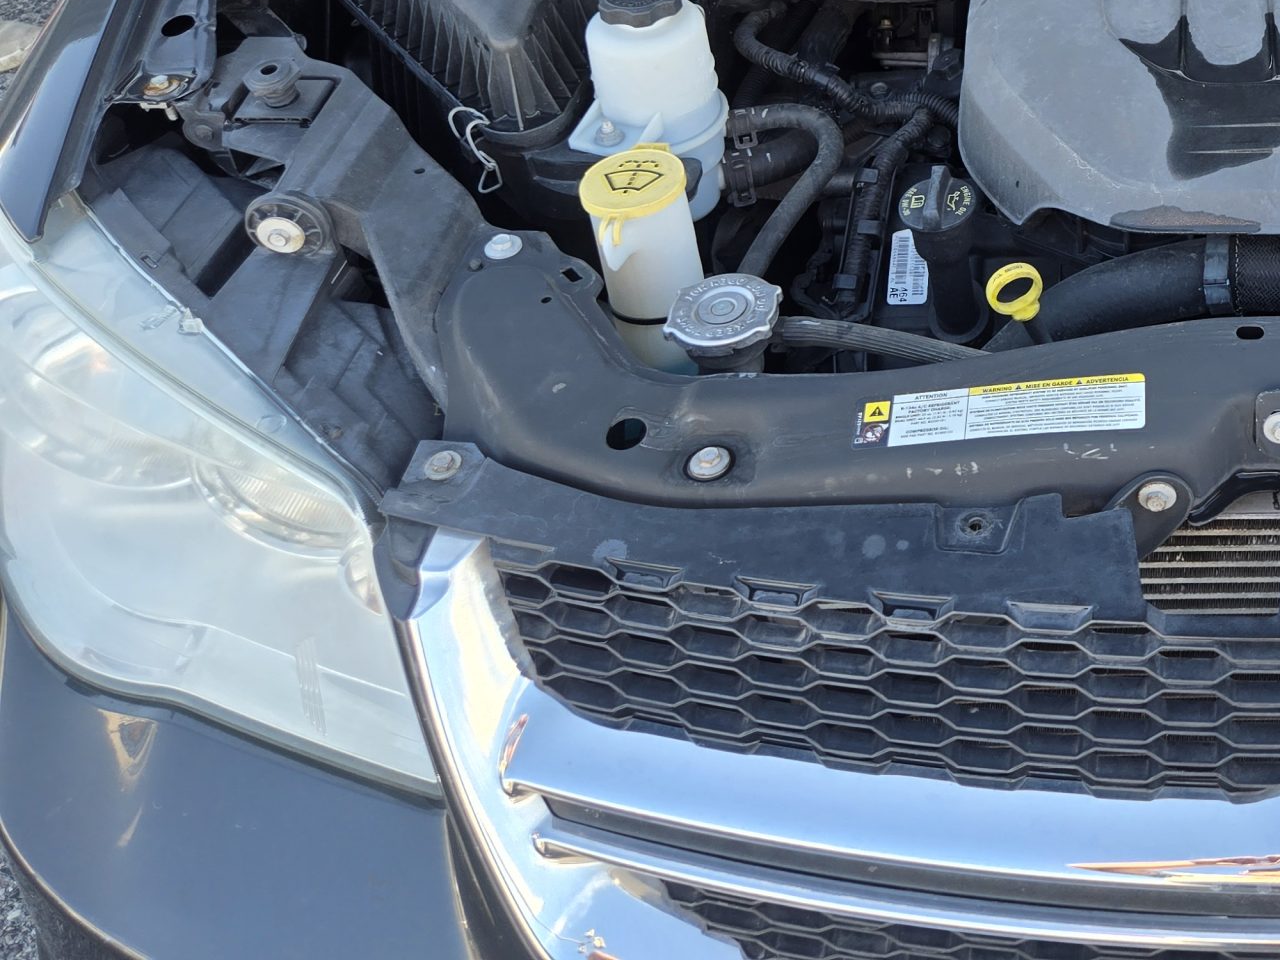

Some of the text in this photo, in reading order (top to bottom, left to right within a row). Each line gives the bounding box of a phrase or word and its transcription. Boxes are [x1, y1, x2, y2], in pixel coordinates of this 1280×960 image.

[955, 186, 971, 215] ENGINE OIL
[982, 385, 1012, 393] WARNING
[1052, 380, 1073, 388] GARDE
[1086, 376, 1129, 384] ADVERTENCIA
[914, 392, 948, 400] ATTENTION
